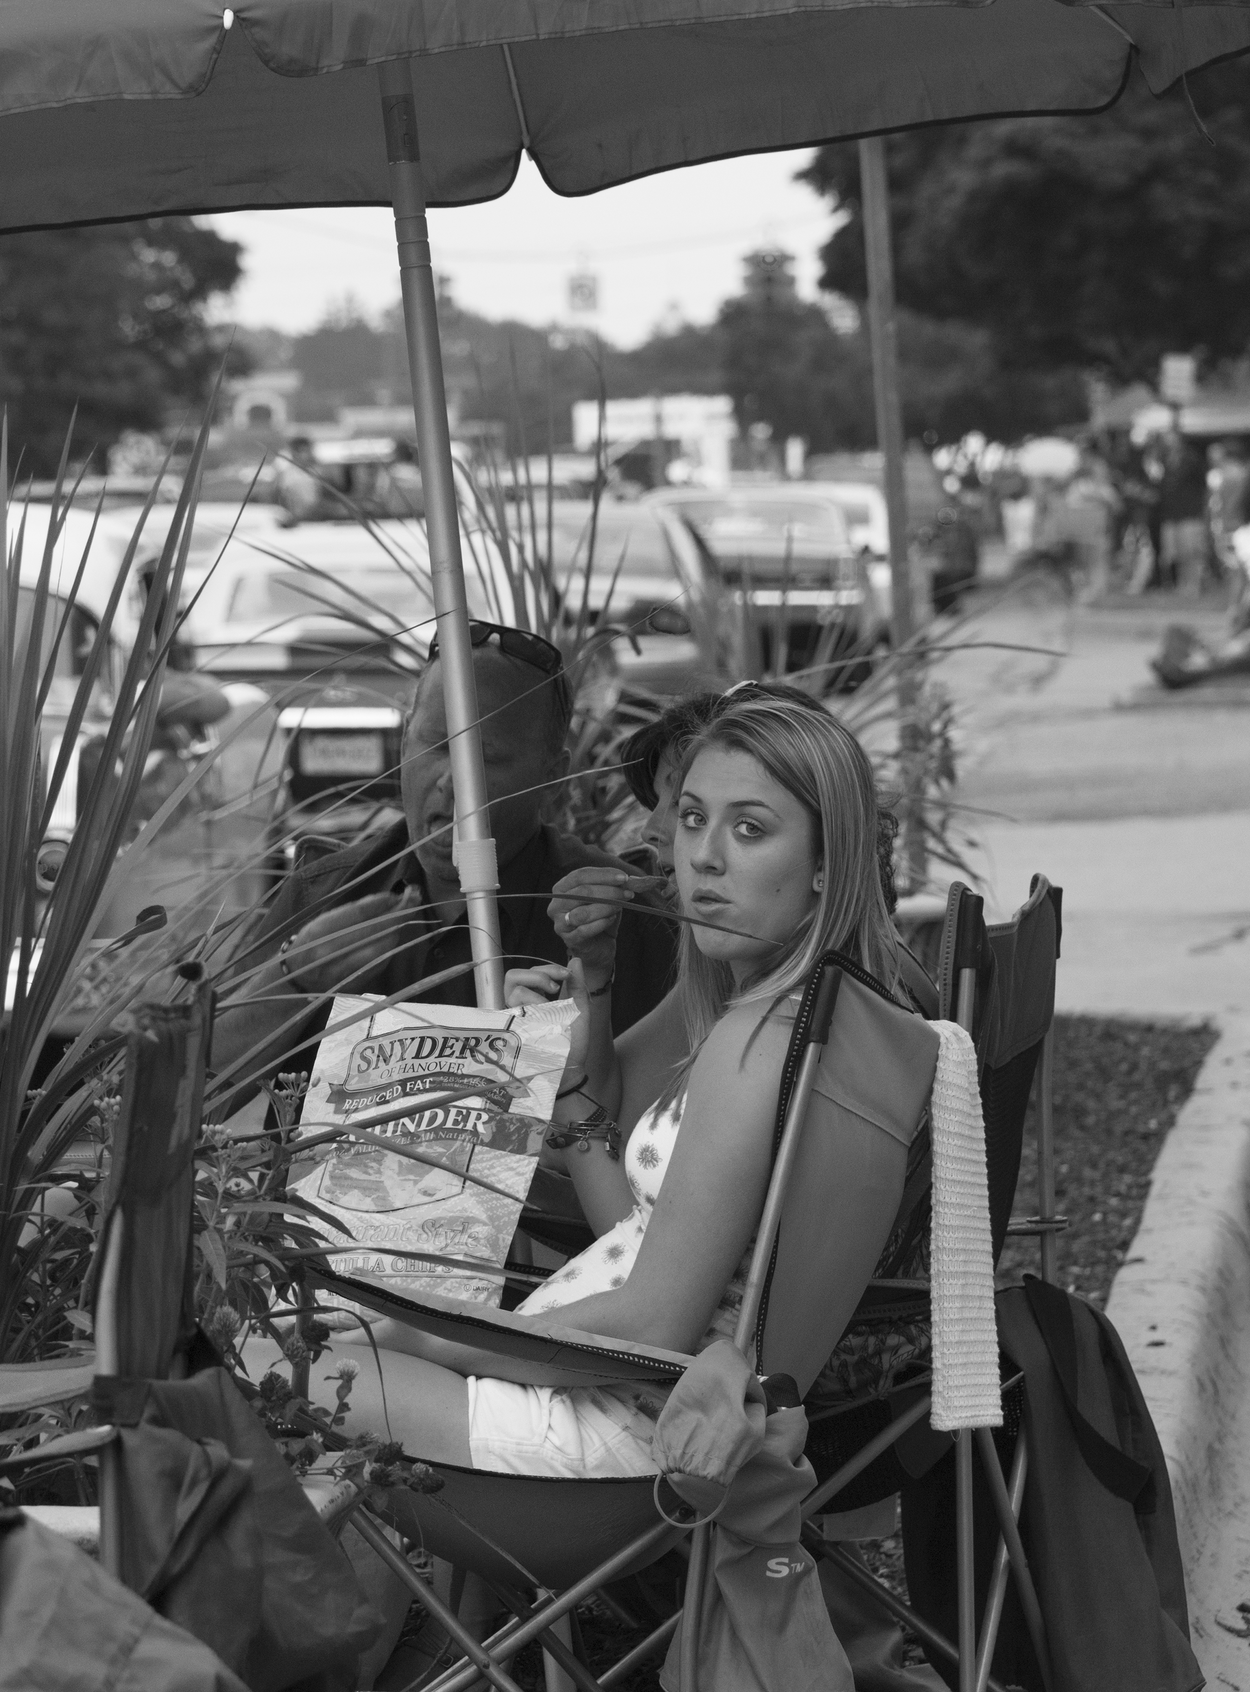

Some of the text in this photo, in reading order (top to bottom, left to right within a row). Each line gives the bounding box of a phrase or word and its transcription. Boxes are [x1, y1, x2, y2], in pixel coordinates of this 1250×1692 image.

[357, 1034, 508, 1074] SNYDER'S
[380, 1060, 465, 1080] OF HANOVER
[342, 1077, 433, 1110] REDUCED FAT
[438, 1130, 482, 1144] Natural
[417, 1218, 479, 1251] Style
